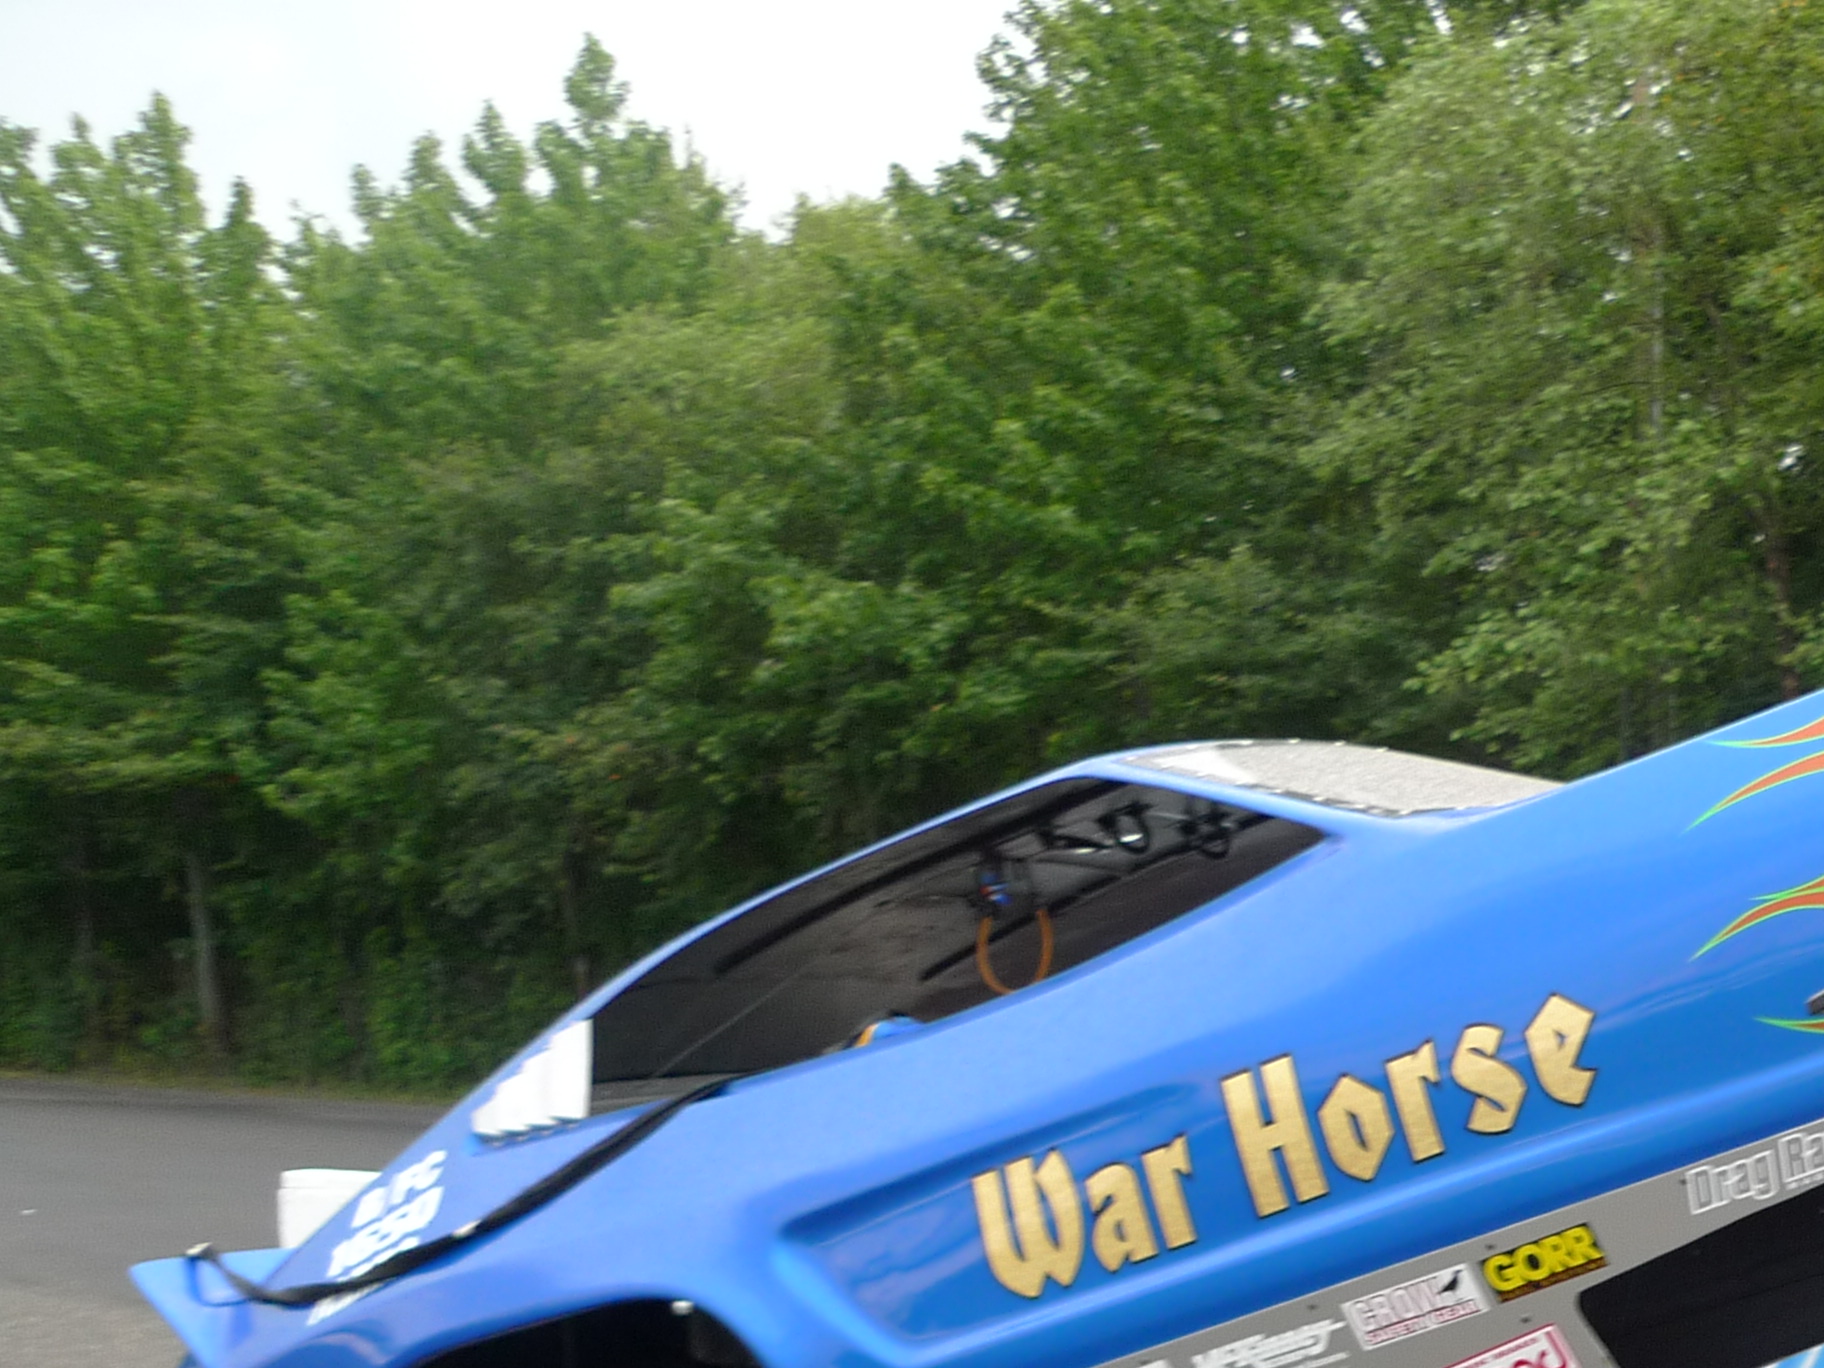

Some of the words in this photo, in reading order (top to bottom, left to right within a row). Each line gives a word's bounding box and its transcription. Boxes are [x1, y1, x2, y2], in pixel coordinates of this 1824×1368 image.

[971, 1133, 1198, 1299] War
[1220, 992, 1597, 1219] Horse
[1685, 1149, 1779, 1216] Drag
[1482, 1225, 1605, 1292] GORR
